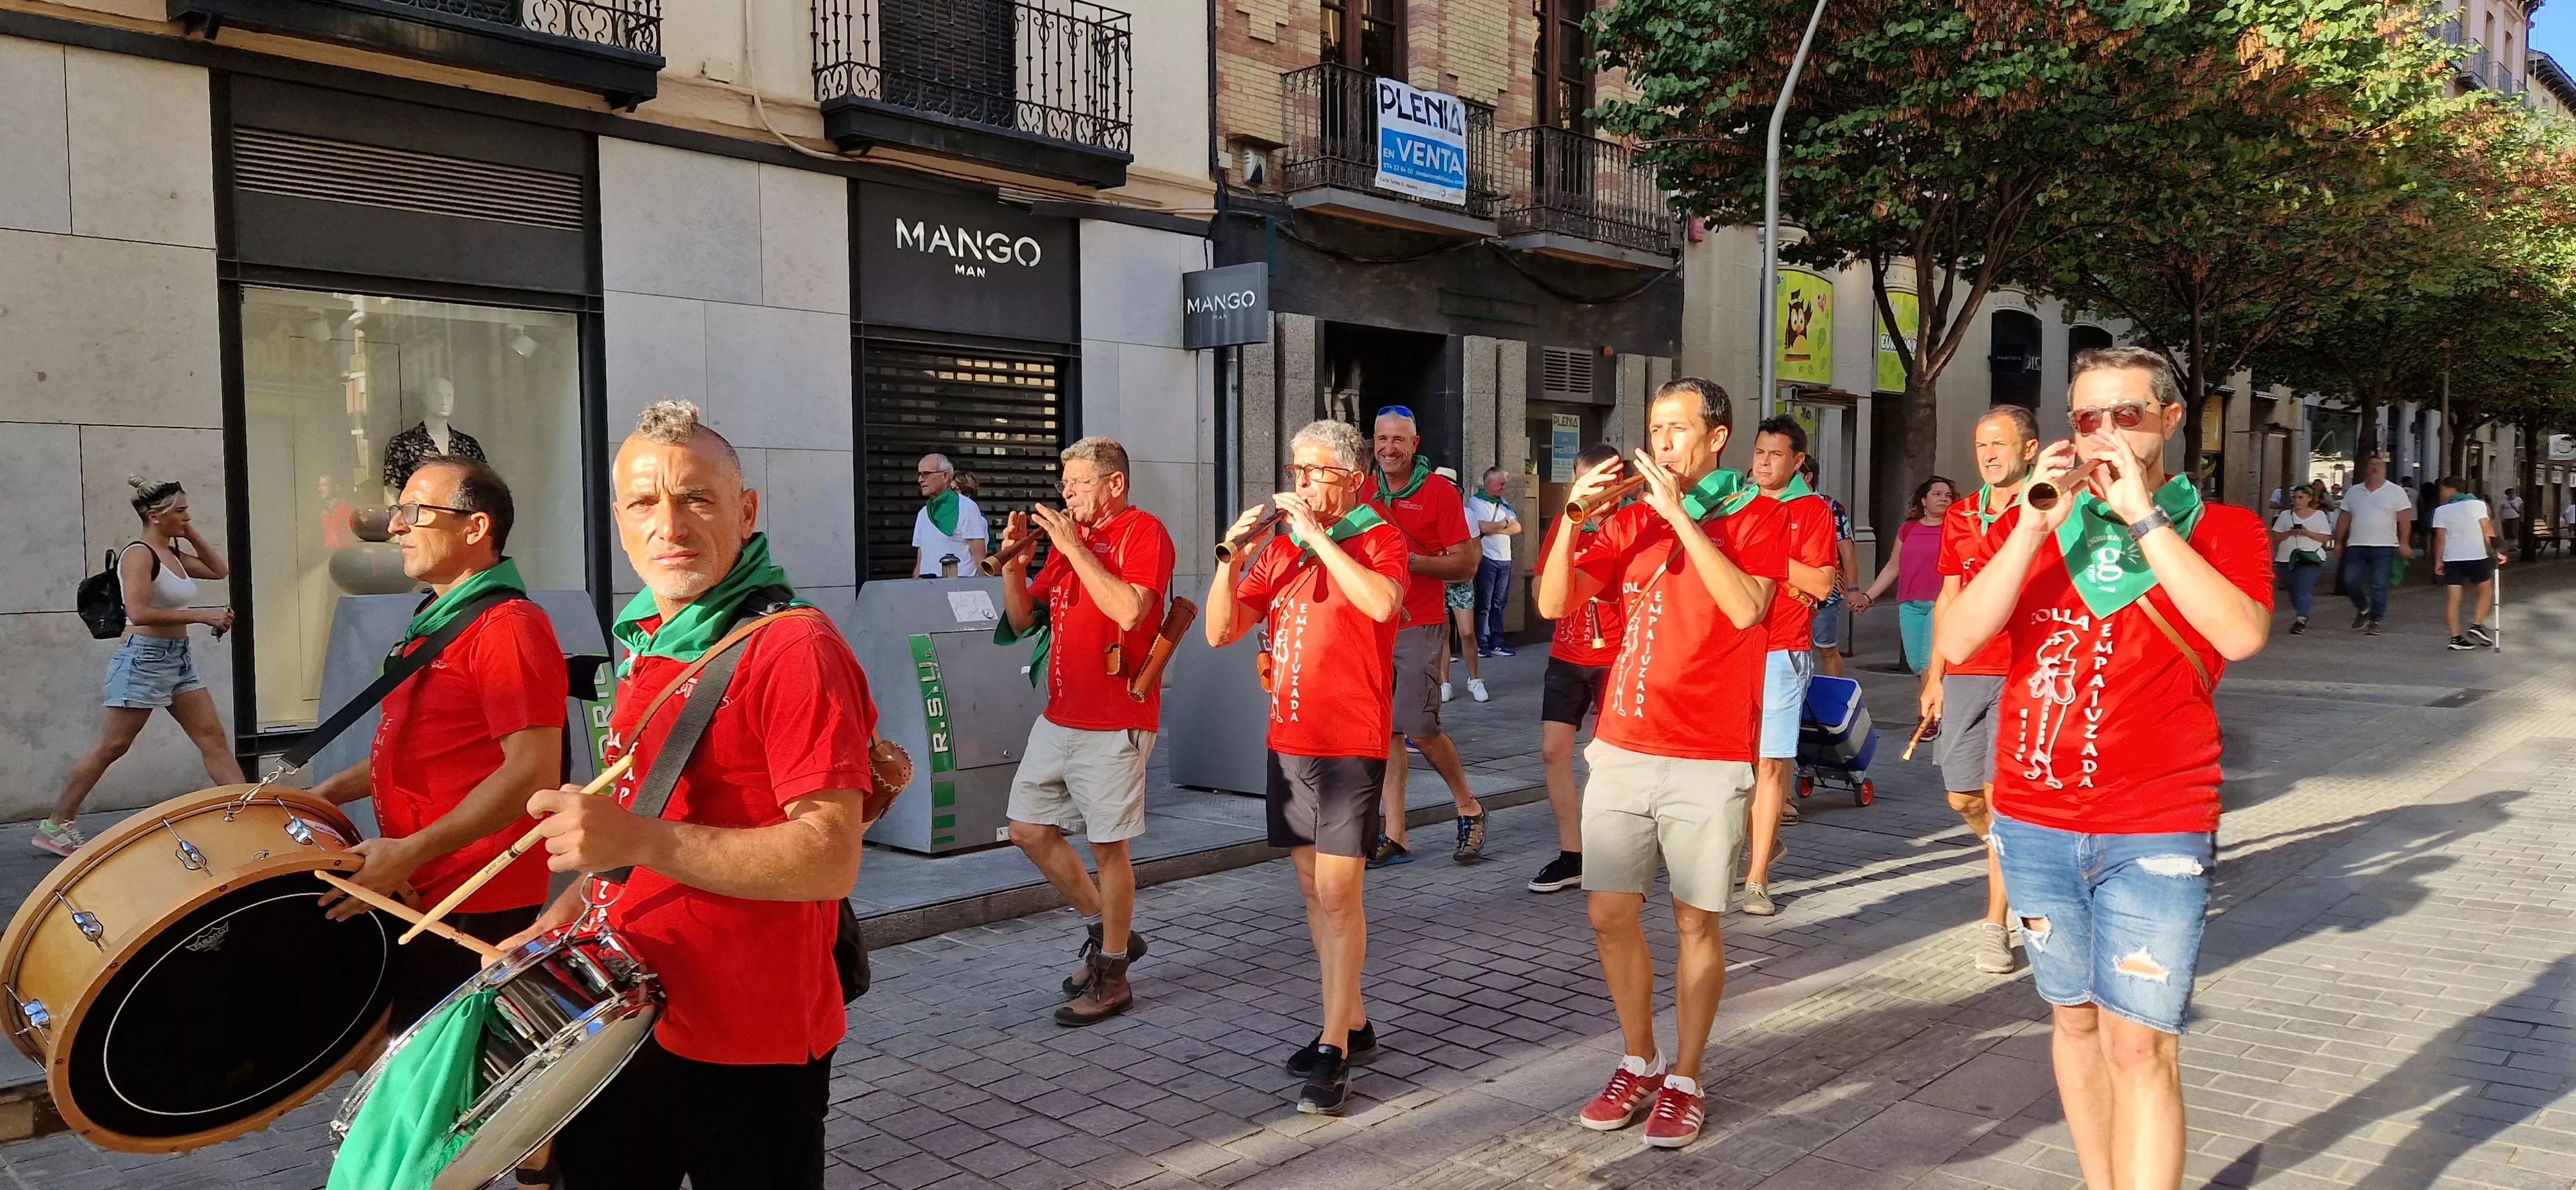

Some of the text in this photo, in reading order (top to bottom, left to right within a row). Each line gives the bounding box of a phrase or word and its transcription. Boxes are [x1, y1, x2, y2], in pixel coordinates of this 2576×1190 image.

[1379, 82, 1463, 136] PLENIA
[1383, 137, 1464, 176] EN VENTA
[896, 217, 1041, 267] MANGO
[954, 263, 986, 278] MAN
[1187, 290, 1256, 315] MANGO
[1553, 415, 1578, 428] PLENIA
[1554, 445, 1577, 455] VENTA
[919, 651, 949, 753] R.S.U.
